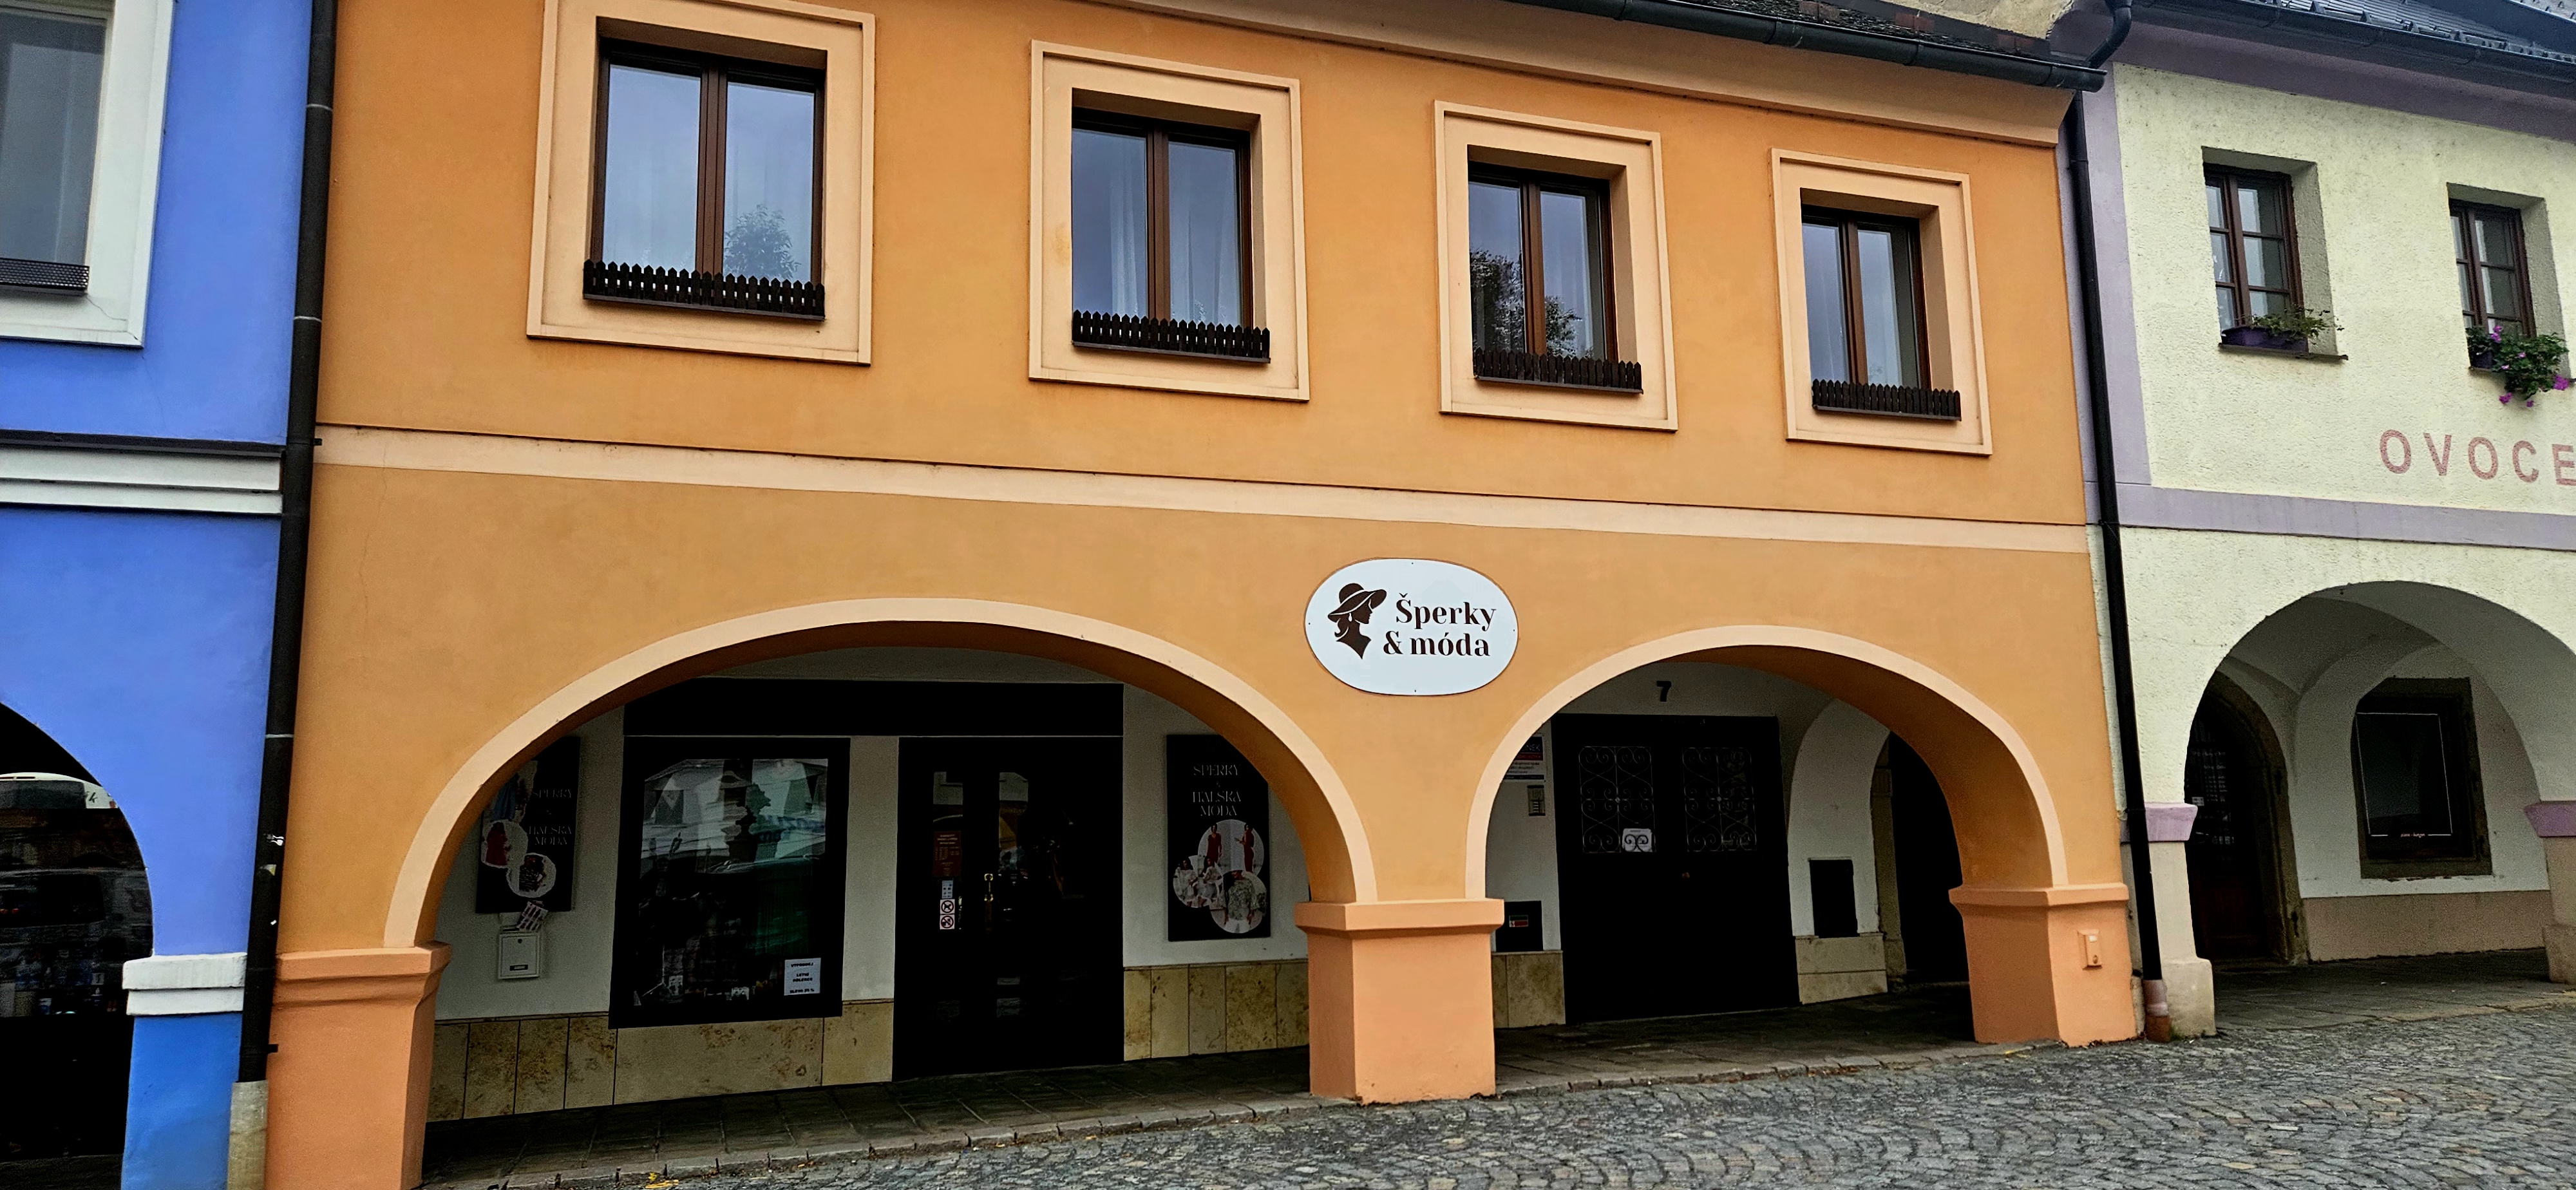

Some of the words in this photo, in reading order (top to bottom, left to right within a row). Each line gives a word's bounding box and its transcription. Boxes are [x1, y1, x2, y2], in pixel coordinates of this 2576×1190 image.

[2380, 429, 2576, 486] OVOCE
[1396, 593, 1496, 632] Šperky
[1383, 630, 1403, 655] &
[1410, 632, 1490, 657] móda
[1656, 680, 1672, 702] 7
